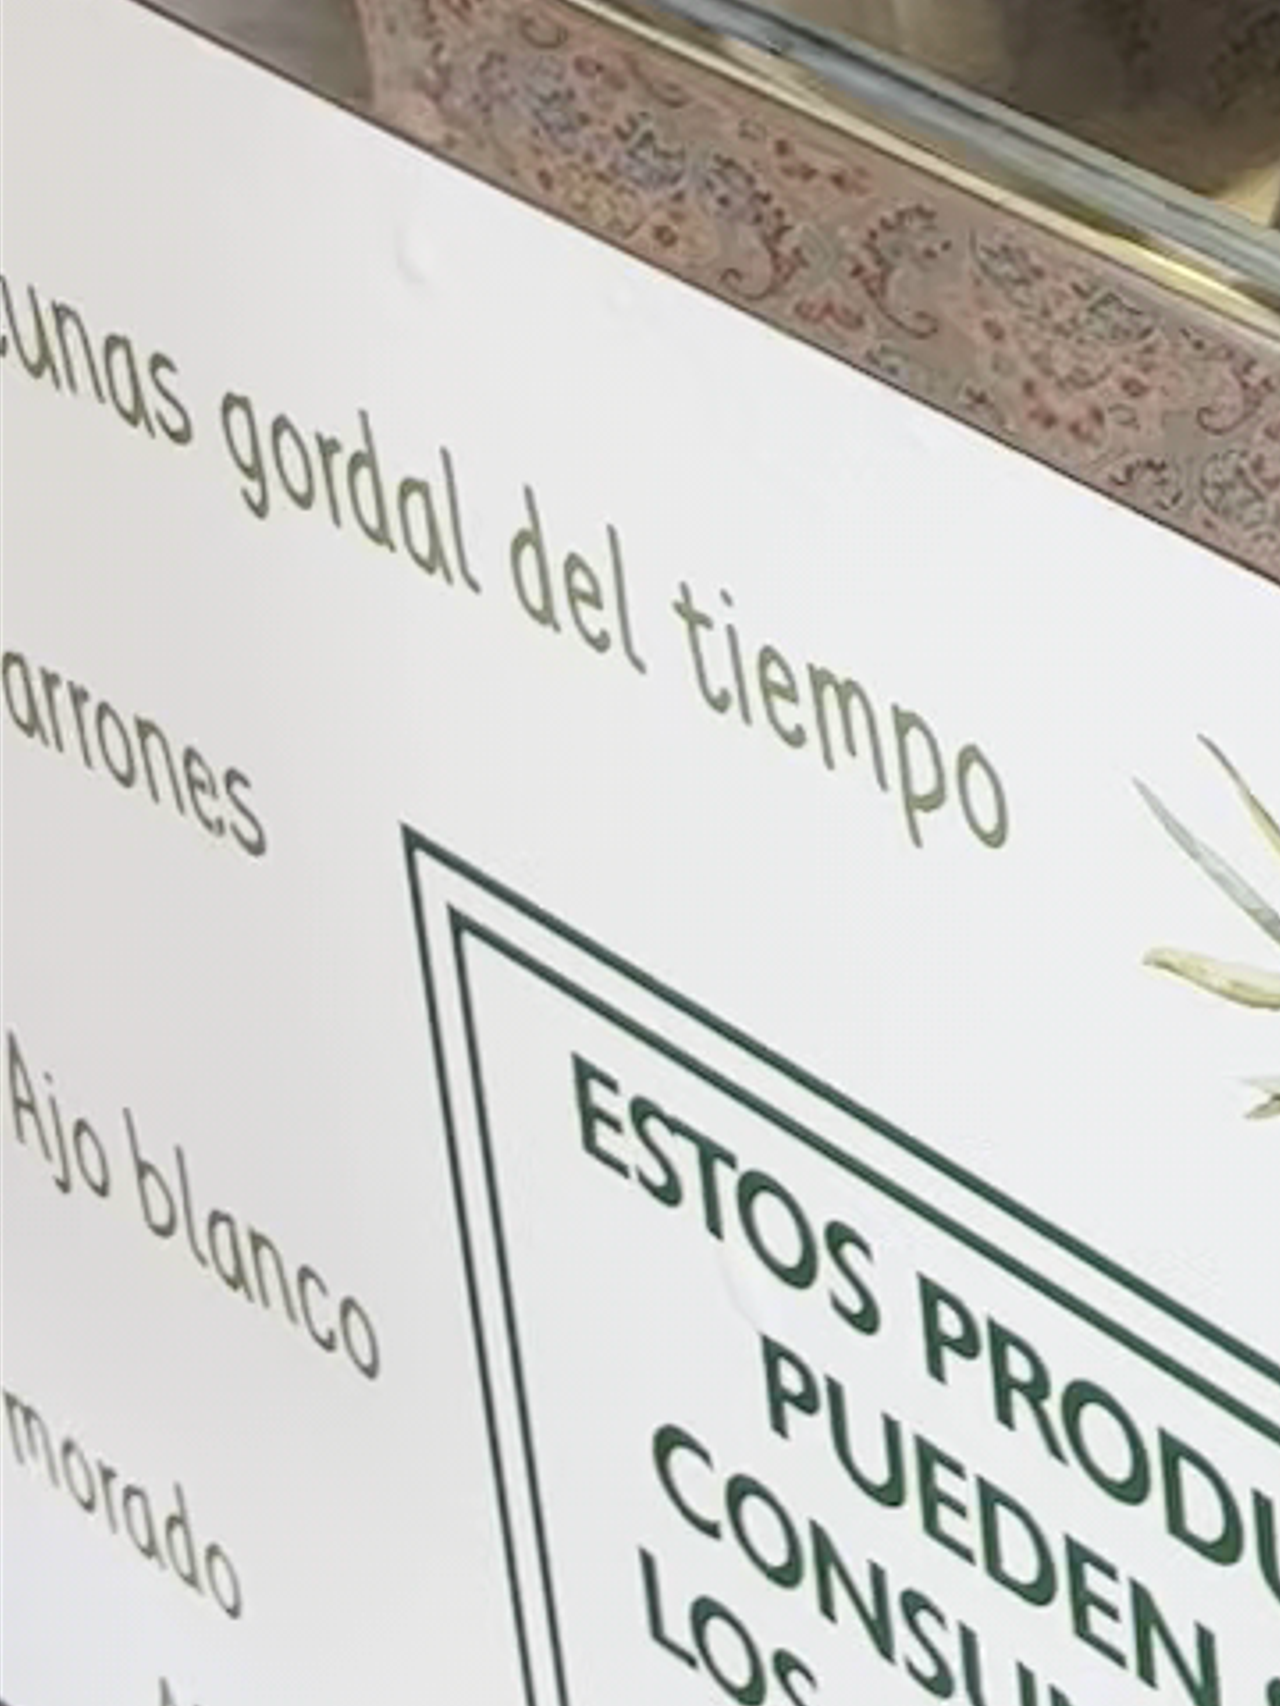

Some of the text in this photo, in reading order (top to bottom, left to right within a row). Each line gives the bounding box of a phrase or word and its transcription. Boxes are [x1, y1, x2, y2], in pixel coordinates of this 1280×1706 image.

[0, 273, 1008, 849] unas gordal del tiempo
[7, 1030, 380, 1382] Ajo blanco
[570, 1051, 881, 1337] ESTOS
[3, 1390, 242, 1620] morado
